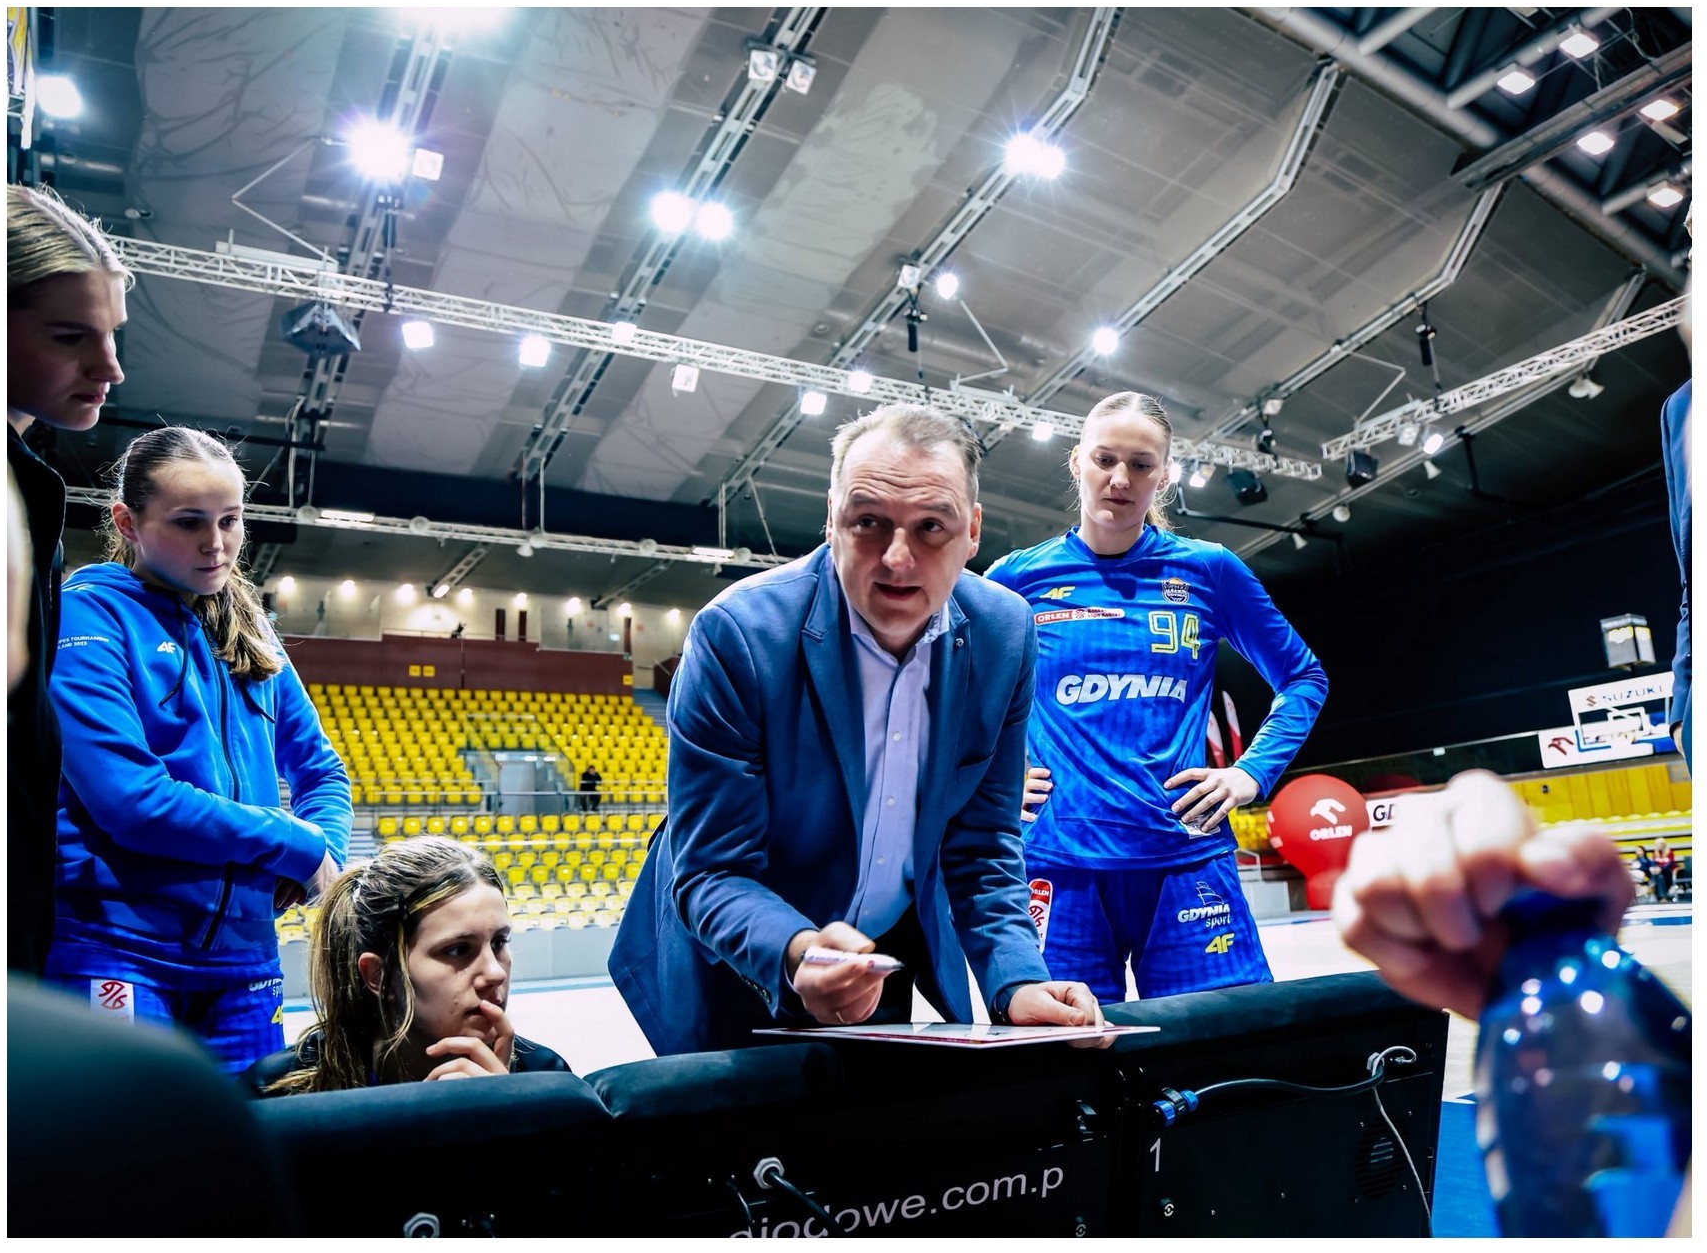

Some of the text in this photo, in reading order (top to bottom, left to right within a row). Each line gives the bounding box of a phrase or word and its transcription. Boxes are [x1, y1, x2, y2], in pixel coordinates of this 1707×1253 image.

[1038, 612, 1070, 623] ORLEN
[1148, 610, 1201, 660] 94
[1056, 673, 1188, 706] GDYNIA
[1309, 824, 1353, 842] ORLEN
[1177, 903, 1231, 924] GDYNIA
[1205, 912, 1232, 930] sport
[271, 1005, 284, 1025] 4
